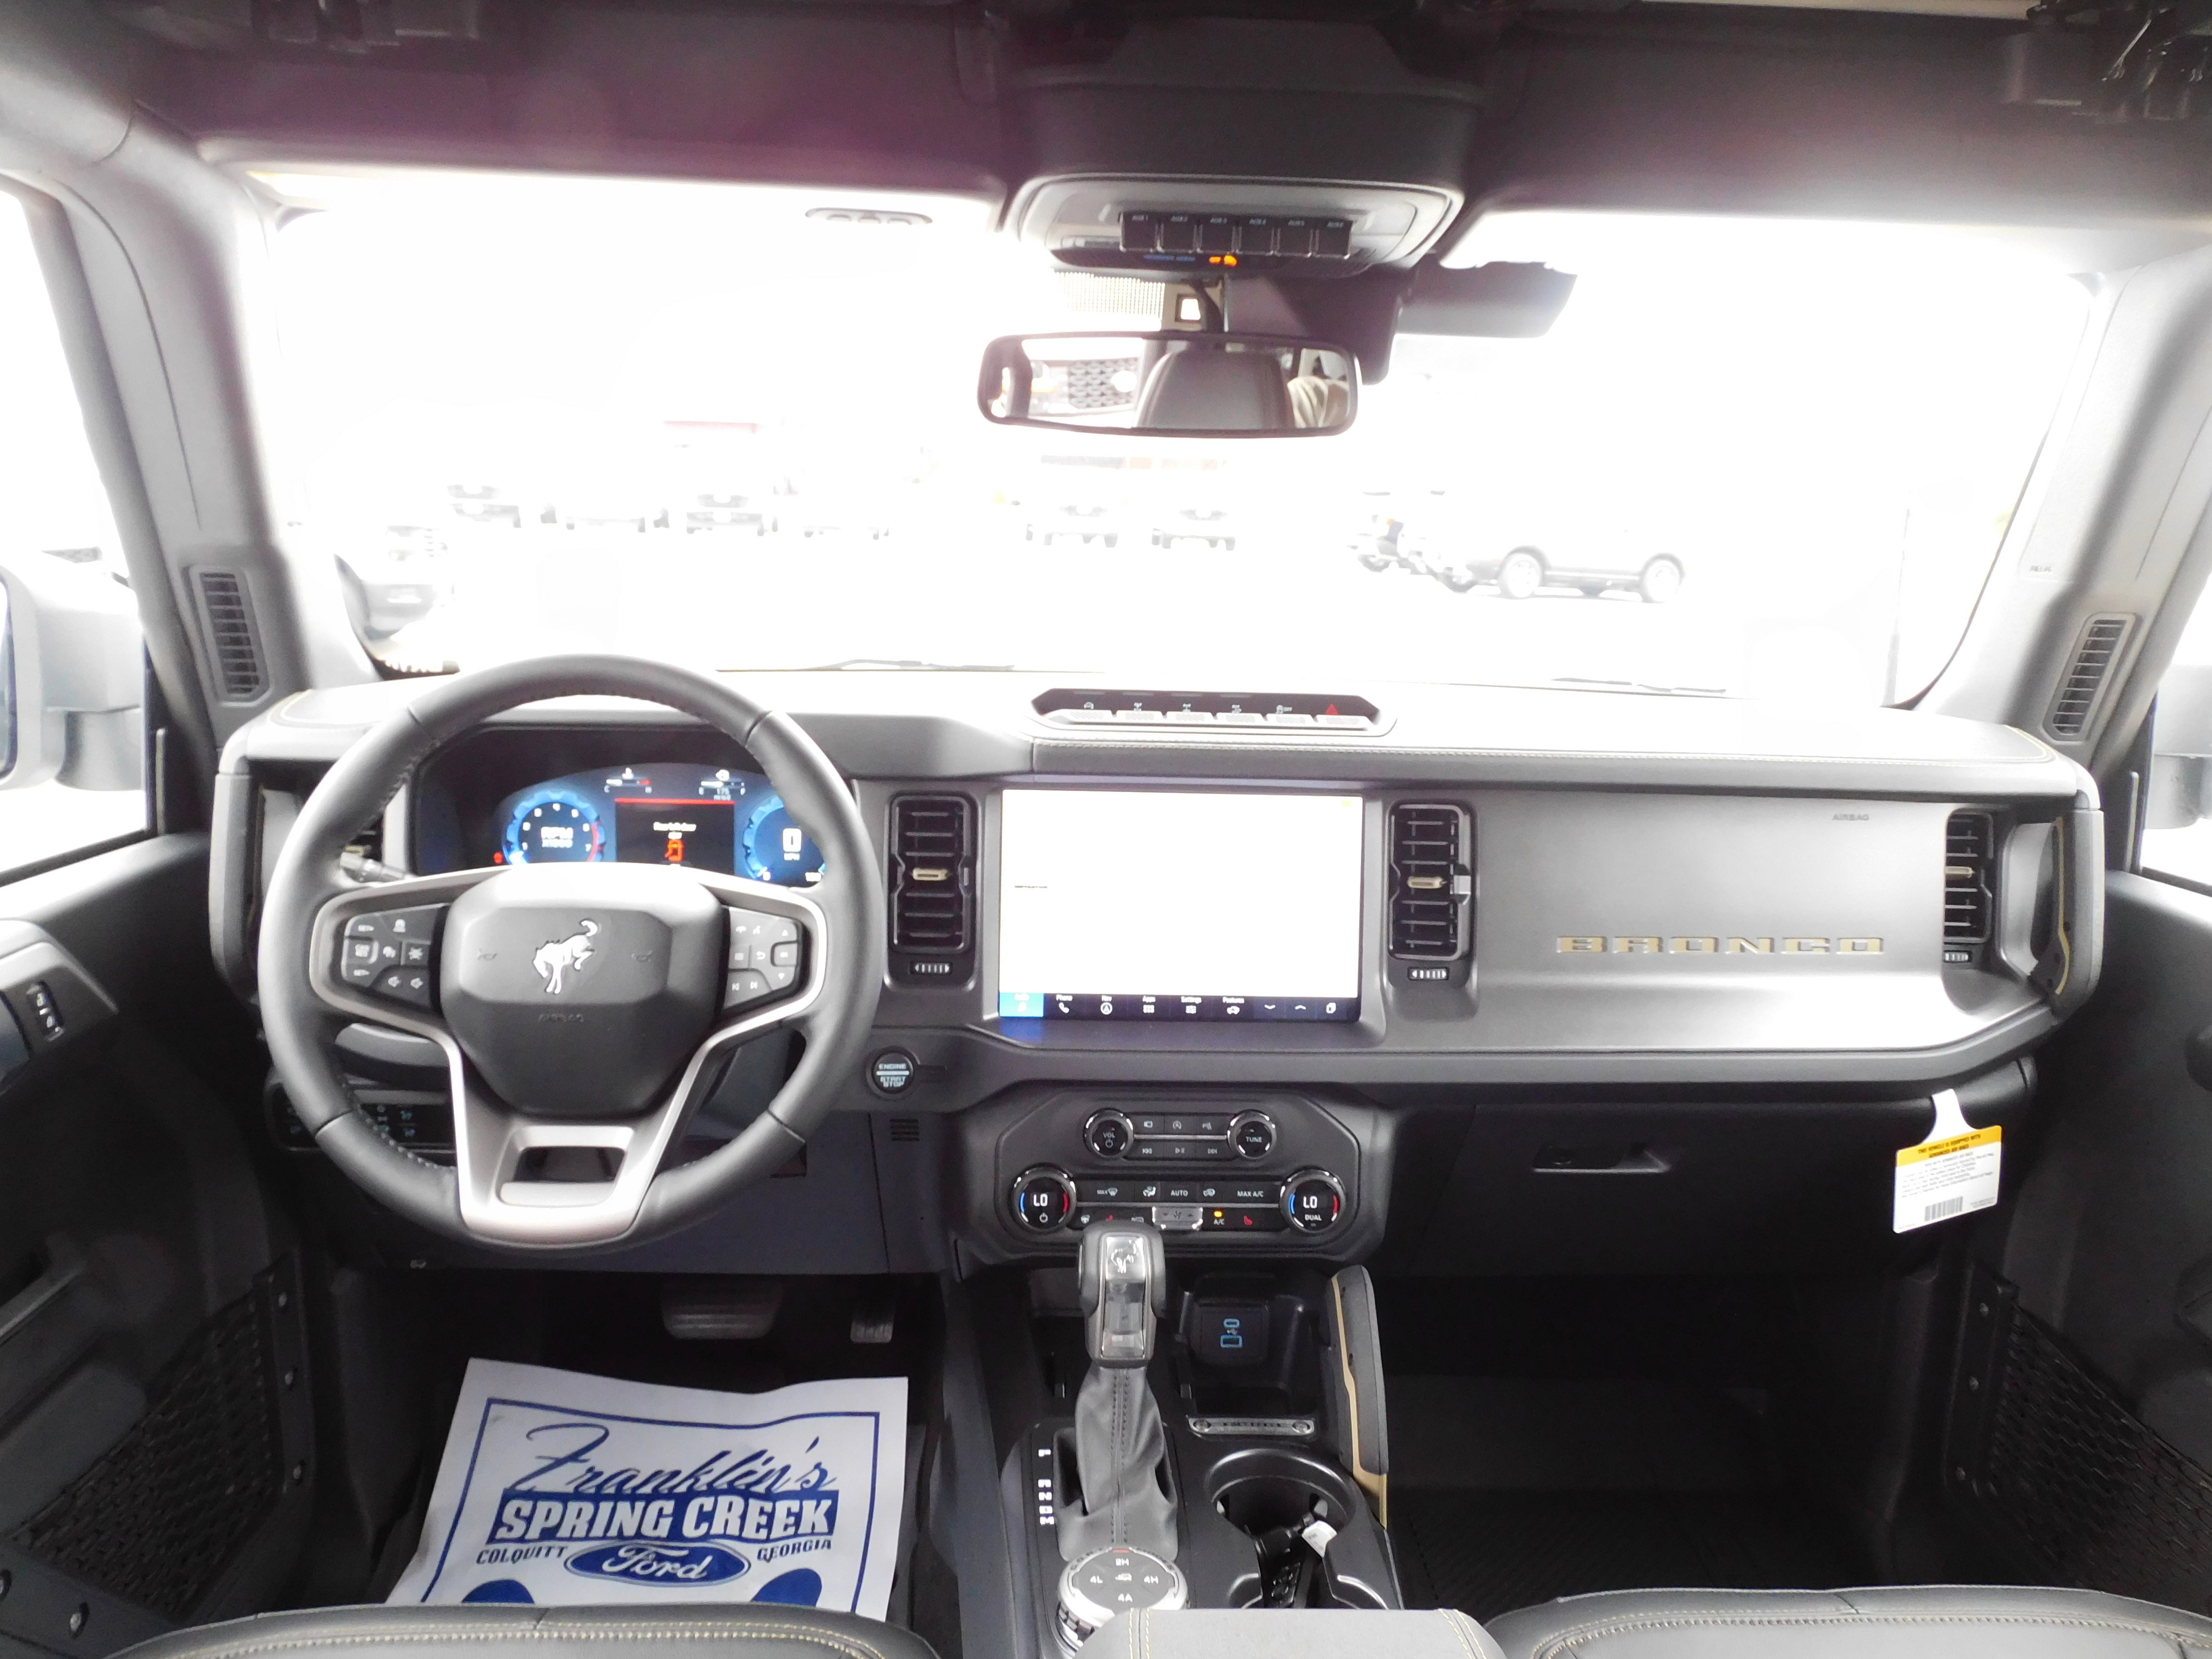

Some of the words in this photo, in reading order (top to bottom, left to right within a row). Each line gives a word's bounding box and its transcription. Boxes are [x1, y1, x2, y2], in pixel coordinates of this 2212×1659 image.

[783, 828, 802, 852] 0
[1556, 936, 1884, 955] BRONCO
[1033, 1193, 1048, 1207] LO
[1303, 1195, 1318, 1209] LO
[509, 1422, 838, 1493] Franklin's
[494, 1496, 676, 1540] SPRING
[682, 1495, 833, 1540] CREEK
[476, 1545, 568, 1564] COLQUITT
[757, 1539, 832, 1563] GEORGIA
[602, 1543, 713, 1579] Ford
[1090, 1575, 1103, 1584] 4L
[1144, 1575, 1159, 1584] 4H
[1118, 1593, 1133, 1602] 4A
